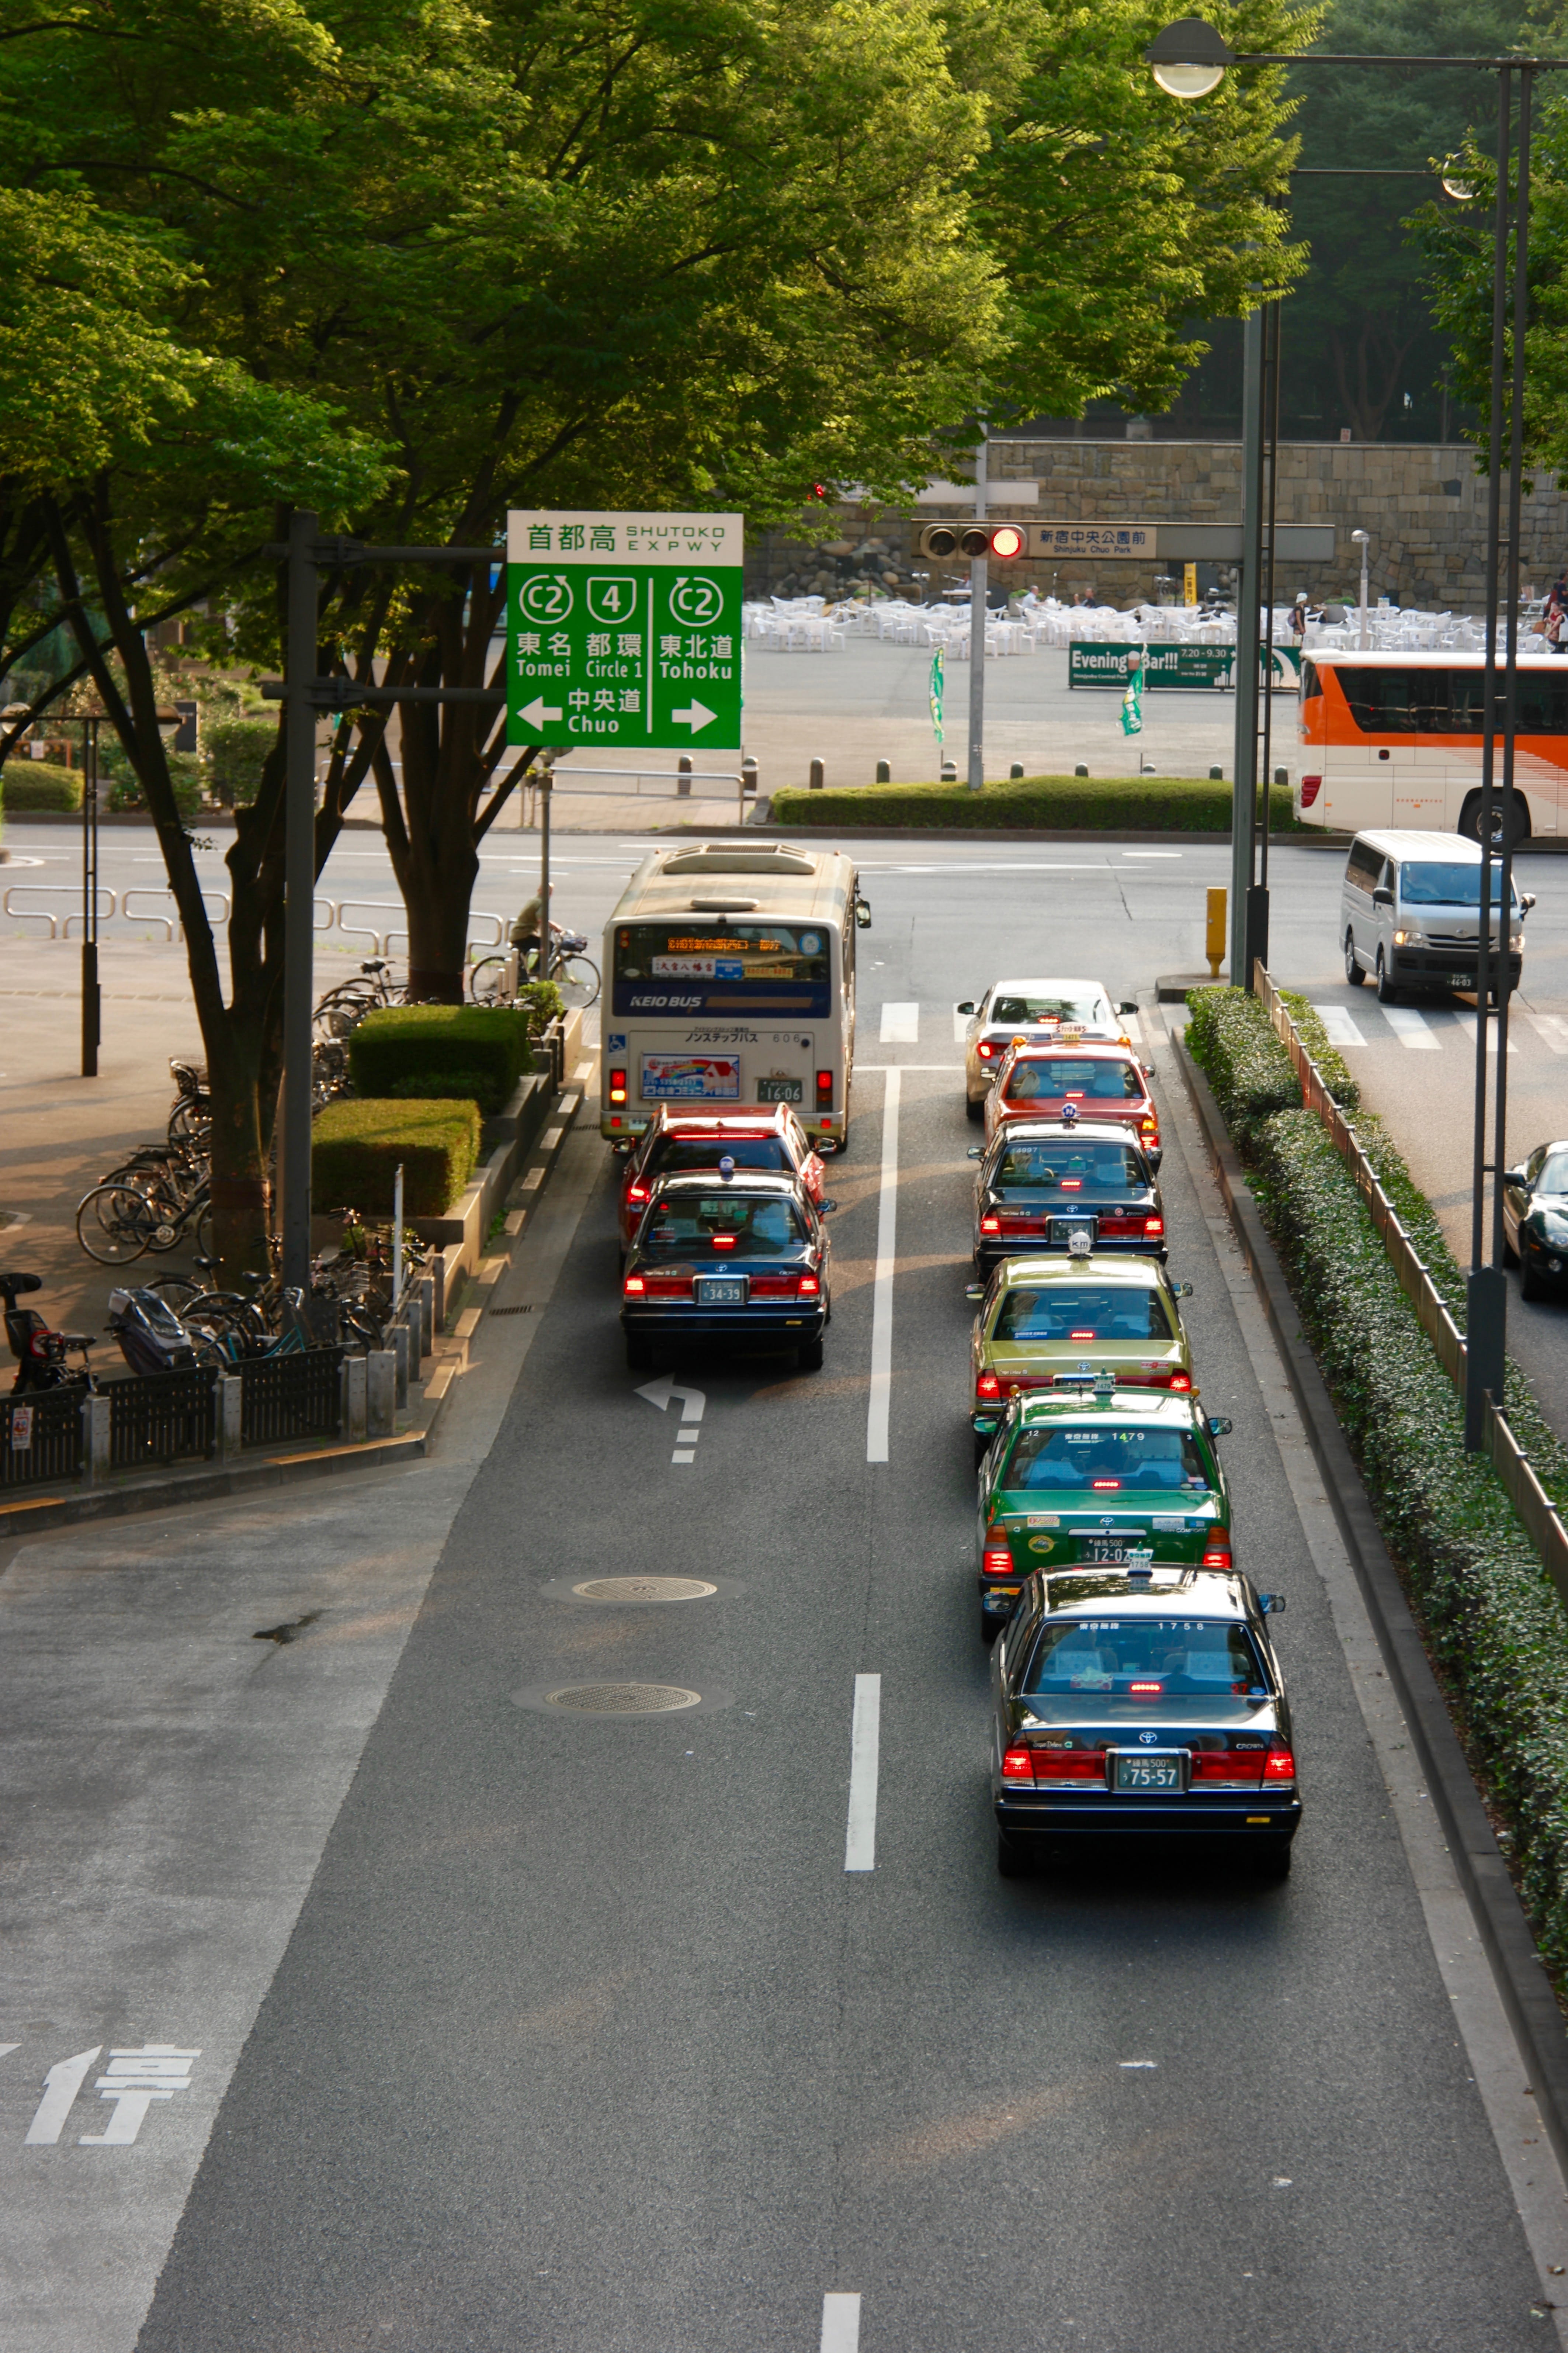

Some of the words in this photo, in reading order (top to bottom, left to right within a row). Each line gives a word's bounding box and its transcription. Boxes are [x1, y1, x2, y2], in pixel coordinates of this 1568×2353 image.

[527, 524, 616, 552] 首都高
[626, 526, 725, 538] SHUTOKO
[1040, 530, 1146, 545] 新宿中央公園前
[1054, 546, 1086, 554] Shinjuku
[528, 585, 563, 613] C2
[601, 585, 621, 612] 4
[678, 588, 713, 616] C2
[516, 631, 571, 656] 東名
[586, 633, 642, 658] 都環
[659, 634, 733, 659] 東北道
[1072, 650, 1128, 674] Evening
[1181, 649, 1200, 658] 7.20
[1206, 649, 1227, 658] 9.30
[516, 660, 570, 677] Tomei
[586, 660, 628, 678] Circle
[634, 662, 643, 678] 1
[659, 661, 732, 679] Tohoku
[568, 688, 641, 713] 中央道
[568, 715, 620, 733] Chuo
[630, 996, 667, 1007] KEIO
[668, 996, 703, 1008] BUS
[685, 1033, 759, 1043] ノンステップバス
[773, 1034, 800, 1043] 606
[710, 1288, 740, 1300] 34-39
[1112, 1432, 1145, 1440] 1479
[1158, 1622, 1204, 1630] 1758
[1132, 1758, 1148, 1767] 練馬
[1151, 1758, 1166, 1767] 500
[1123, 1772, 1128, 1781] う
[1131, 1768, 1176, 1785] 75-57
